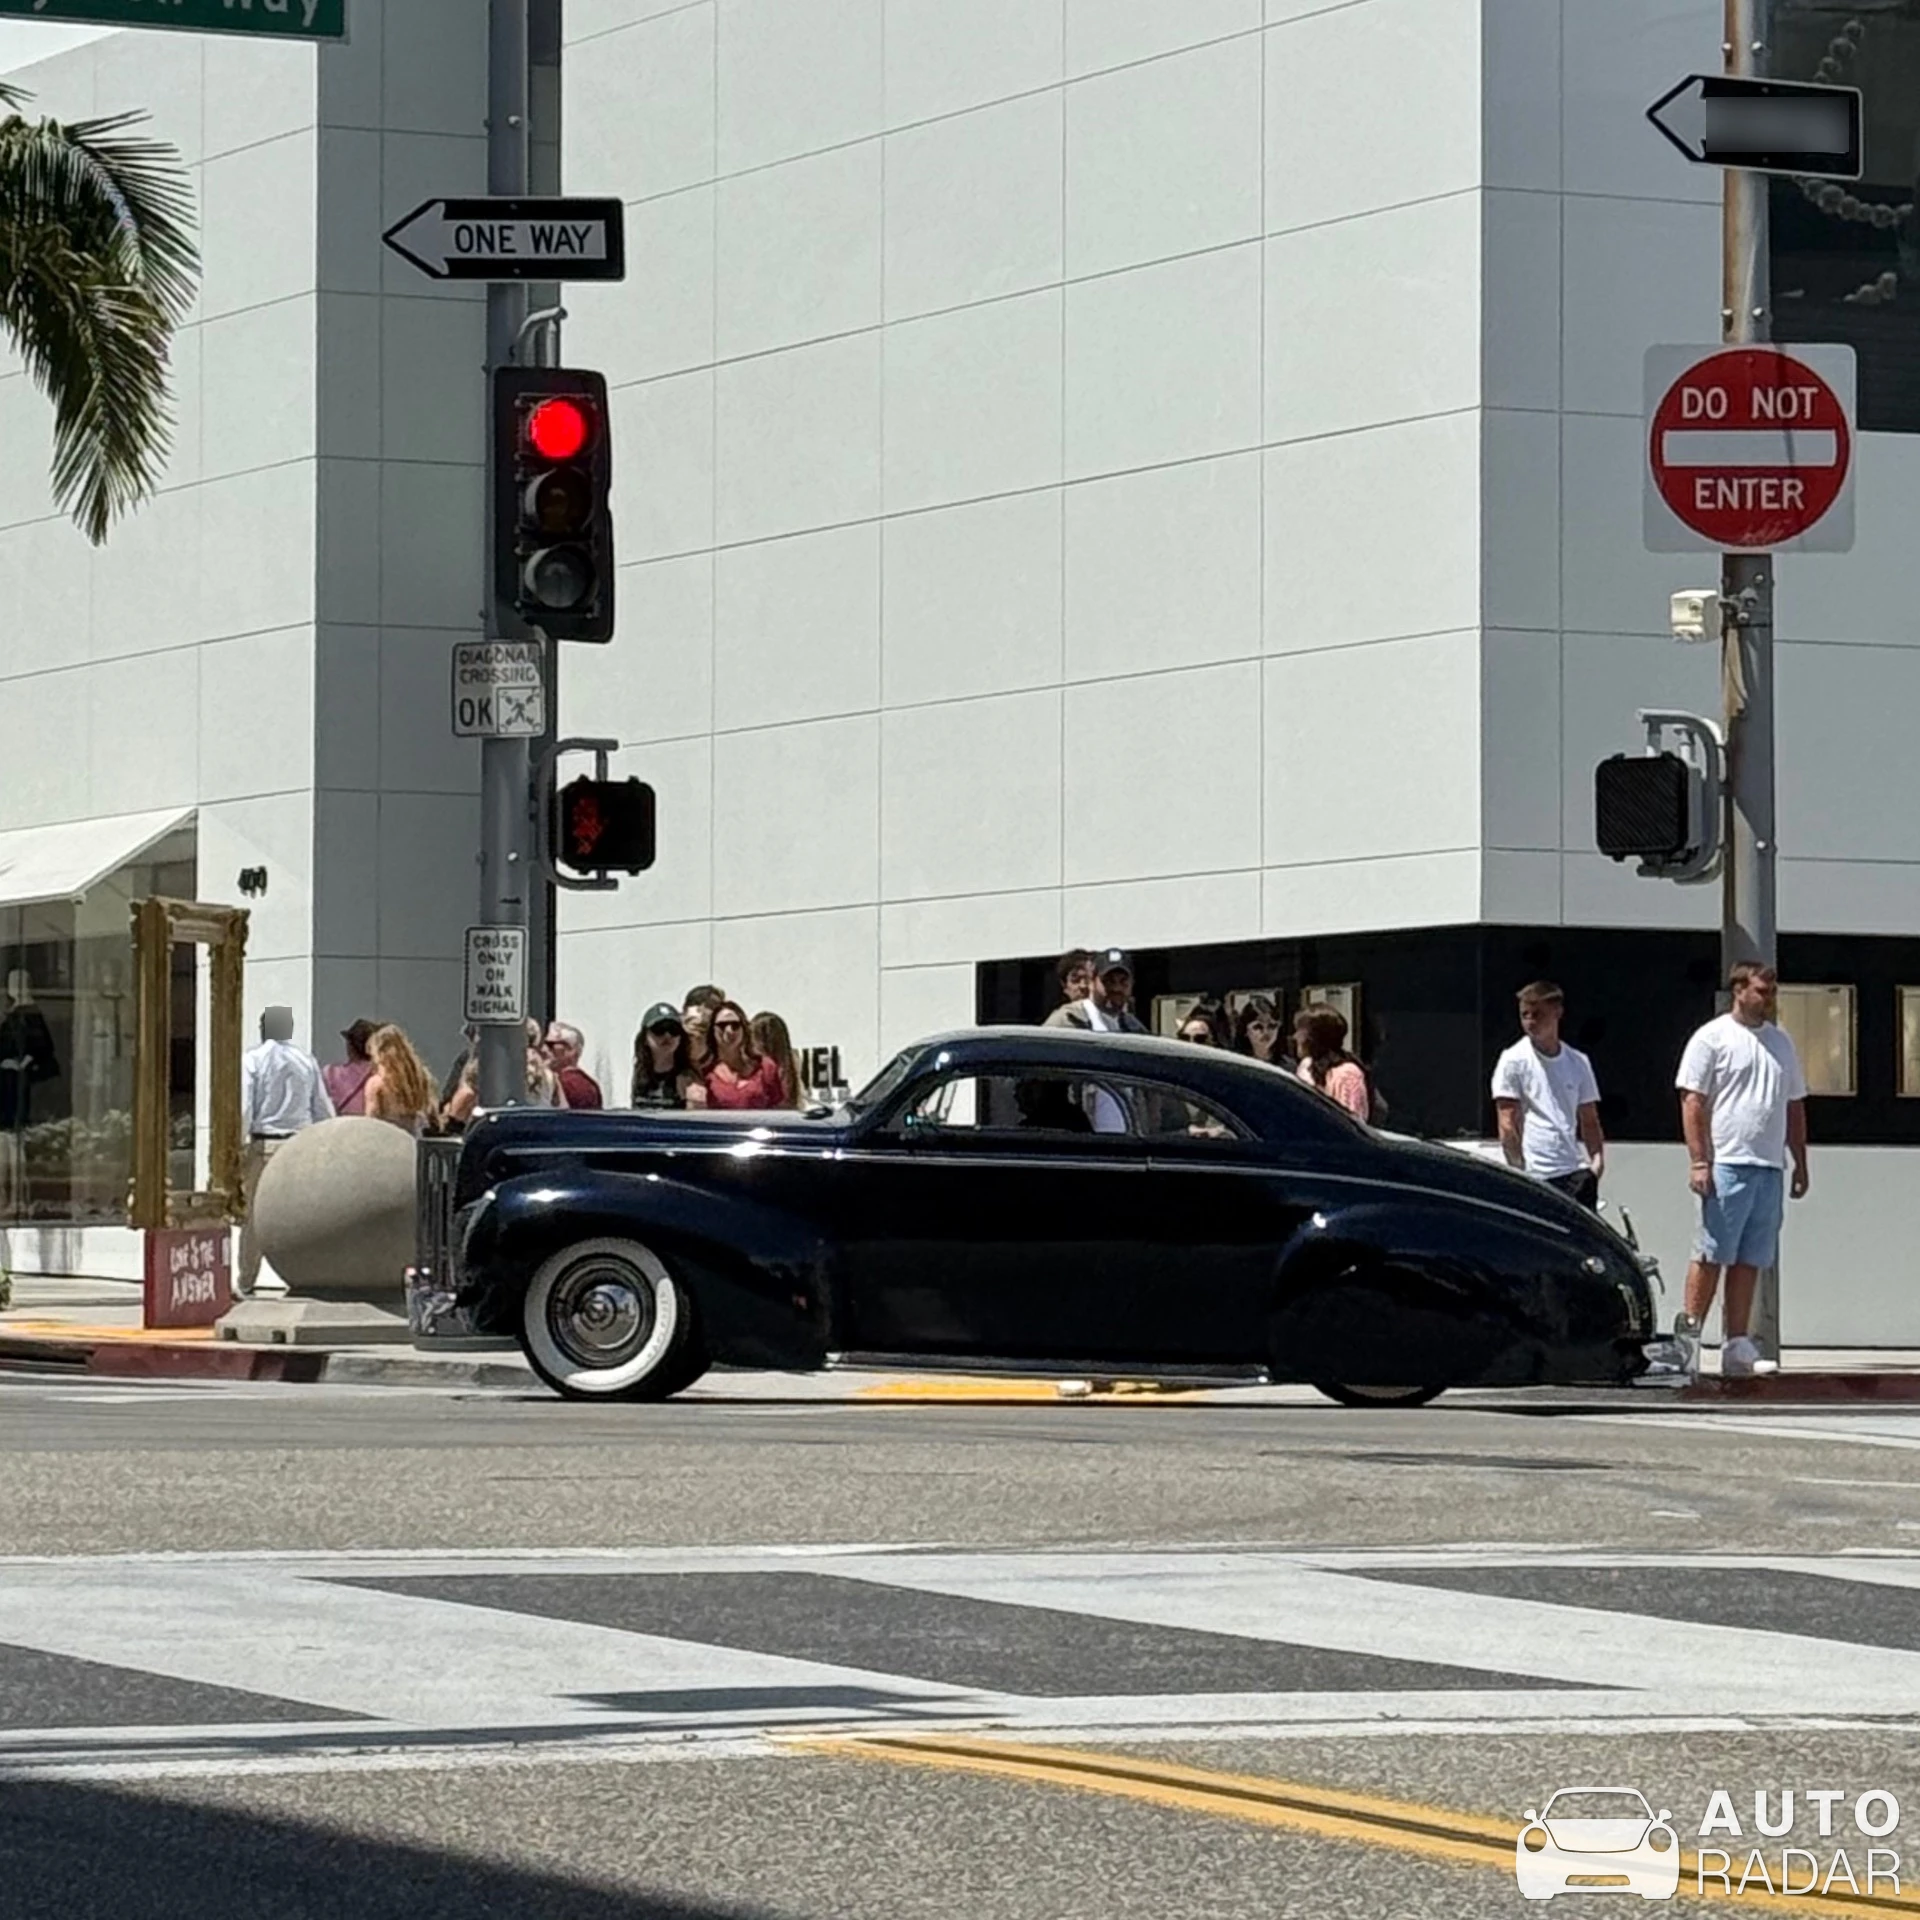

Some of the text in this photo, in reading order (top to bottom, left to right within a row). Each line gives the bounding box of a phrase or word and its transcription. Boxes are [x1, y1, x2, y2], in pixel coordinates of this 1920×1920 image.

[454, 224, 592, 254] ONE WAY
[1681, 386, 1819, 420] DO NOT
[1694, 477, 1805, 511] ENTER
[460, 665, 536, 685] CROSSING
[459, 697, 493, 727] OK
[472, 935, 518, 949] CROSS
[477, 951, 513, 966] ONLY
[485, 968, 505, 982] ON
[476, 984, 513, 998] WALK
[470, 1000, 518, 1014] SIGNAL
